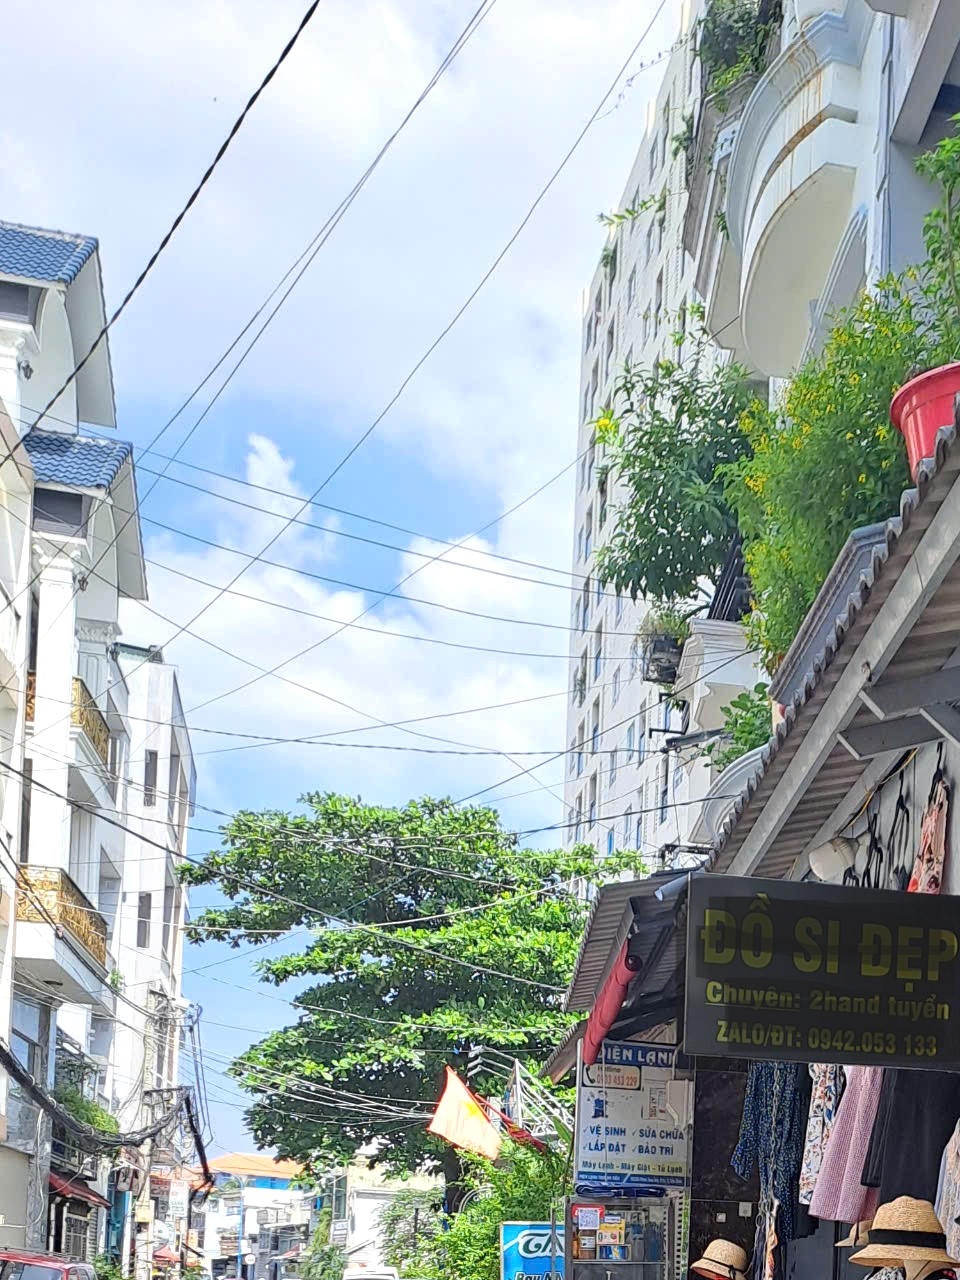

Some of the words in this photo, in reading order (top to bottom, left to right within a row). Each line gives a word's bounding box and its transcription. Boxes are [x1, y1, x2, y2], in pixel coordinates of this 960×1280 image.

[700, 892, 774, 969] ĐỒ
[792, 916, 841, 974] SI
[857, 922, 959, 993] ĐẸP
[705, 980, 802, 1011] Chuyên:
[809, 989, 880, 1015] 2hand
[888, 993, 951, 1022] tuyển
[716, 1019, 802, 1049] ZALO/ĐT:
[808, 1026, 897, 1056] 0942.053
[903, 1034, 937, 1057] 133
[605, 1126, 626, 1137] SINH
